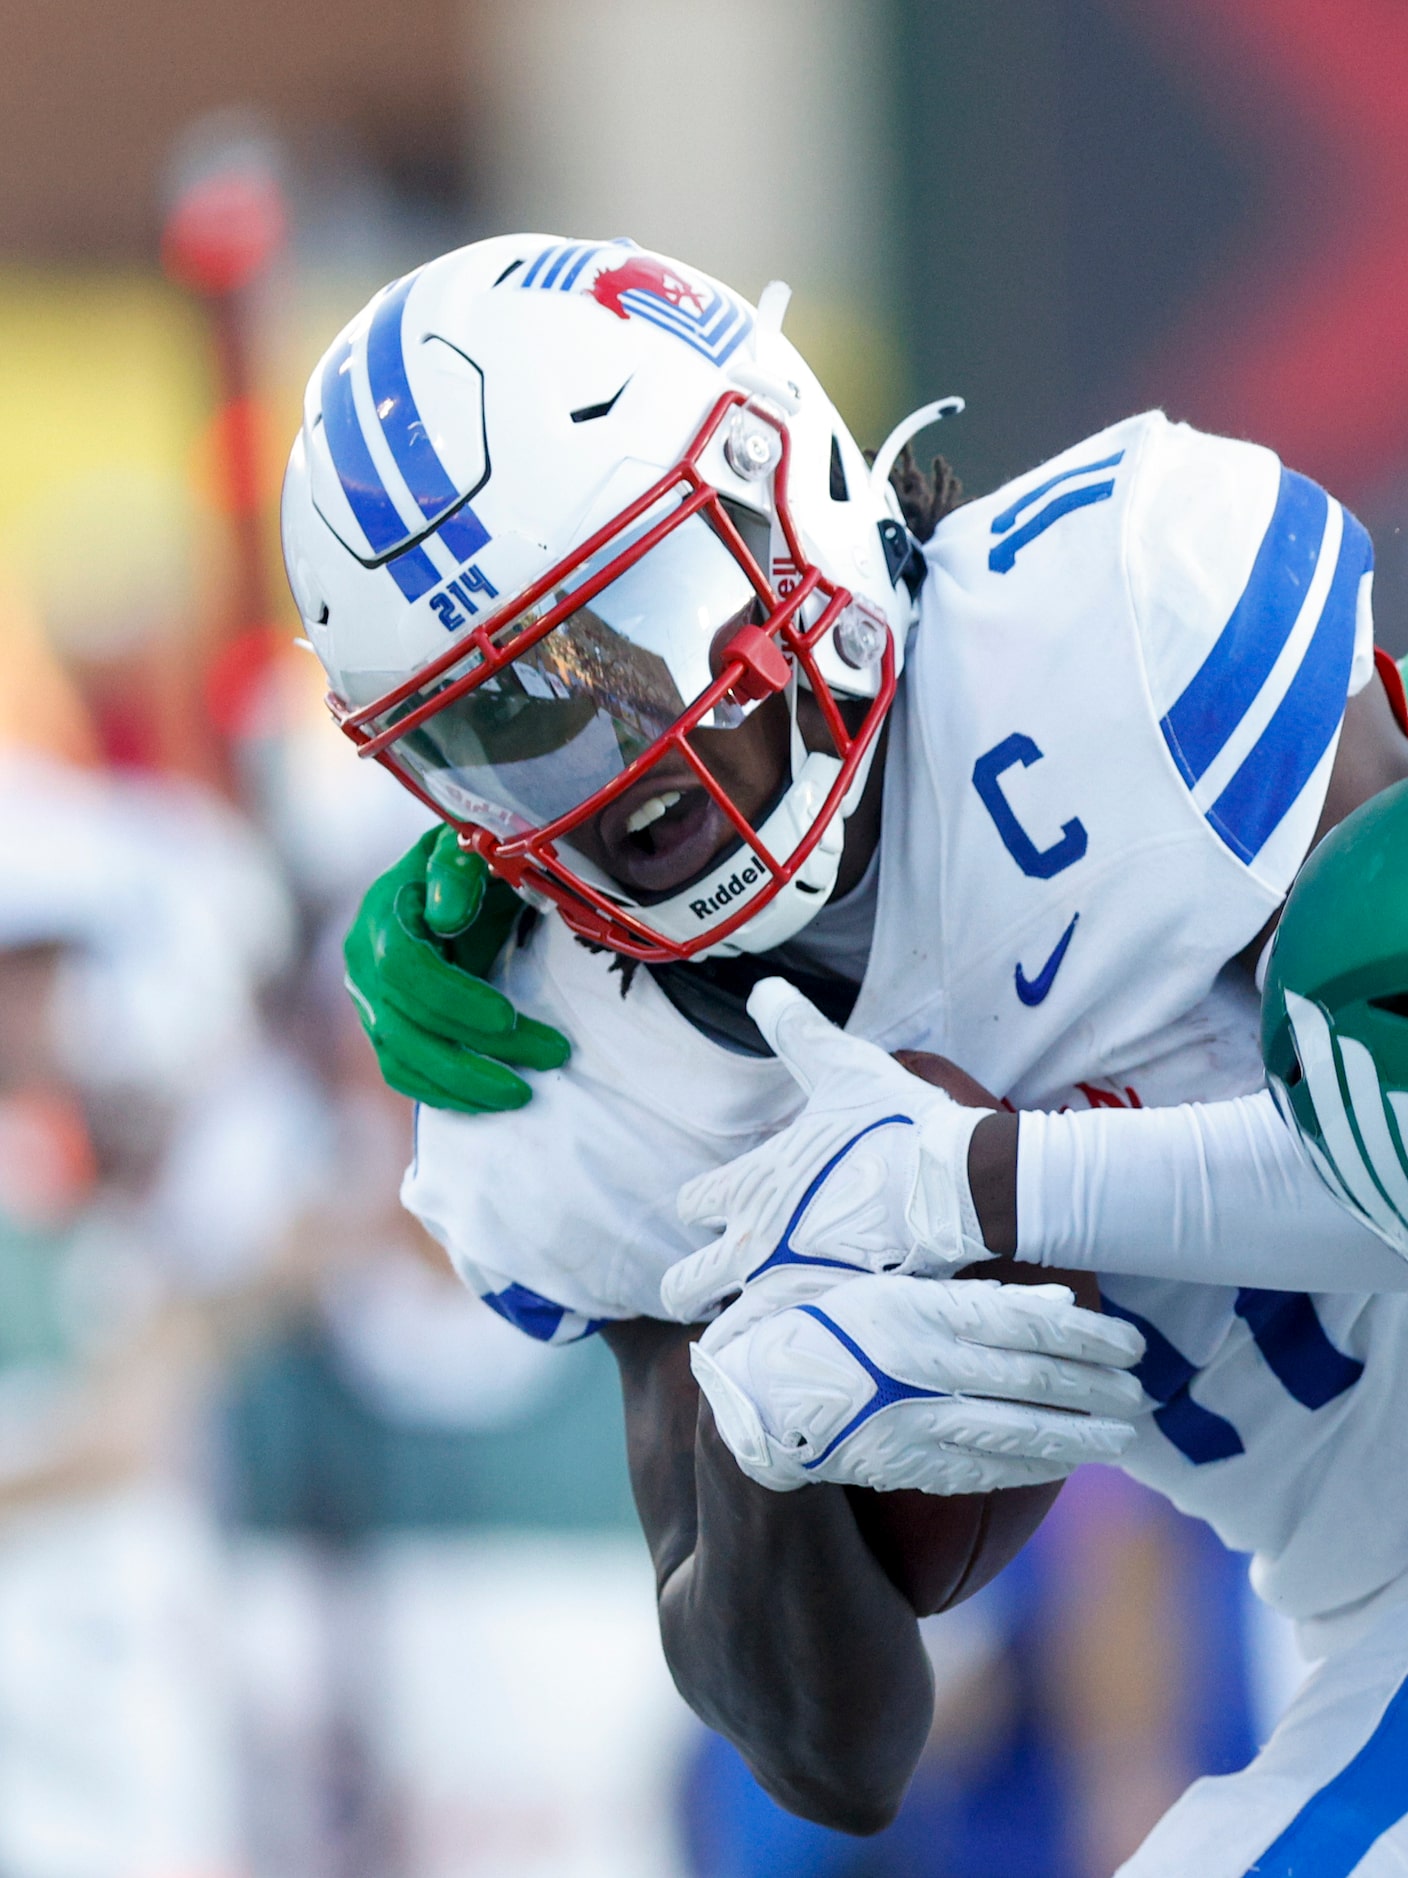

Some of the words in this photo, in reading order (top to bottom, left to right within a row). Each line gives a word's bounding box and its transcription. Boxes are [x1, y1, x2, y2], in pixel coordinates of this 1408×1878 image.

[987, 448, 1127, 575] 11
[429, 563, 500, 633] 214
[971, 731, 1089, 880] C
[688, 855, 766, 921] Riddel
